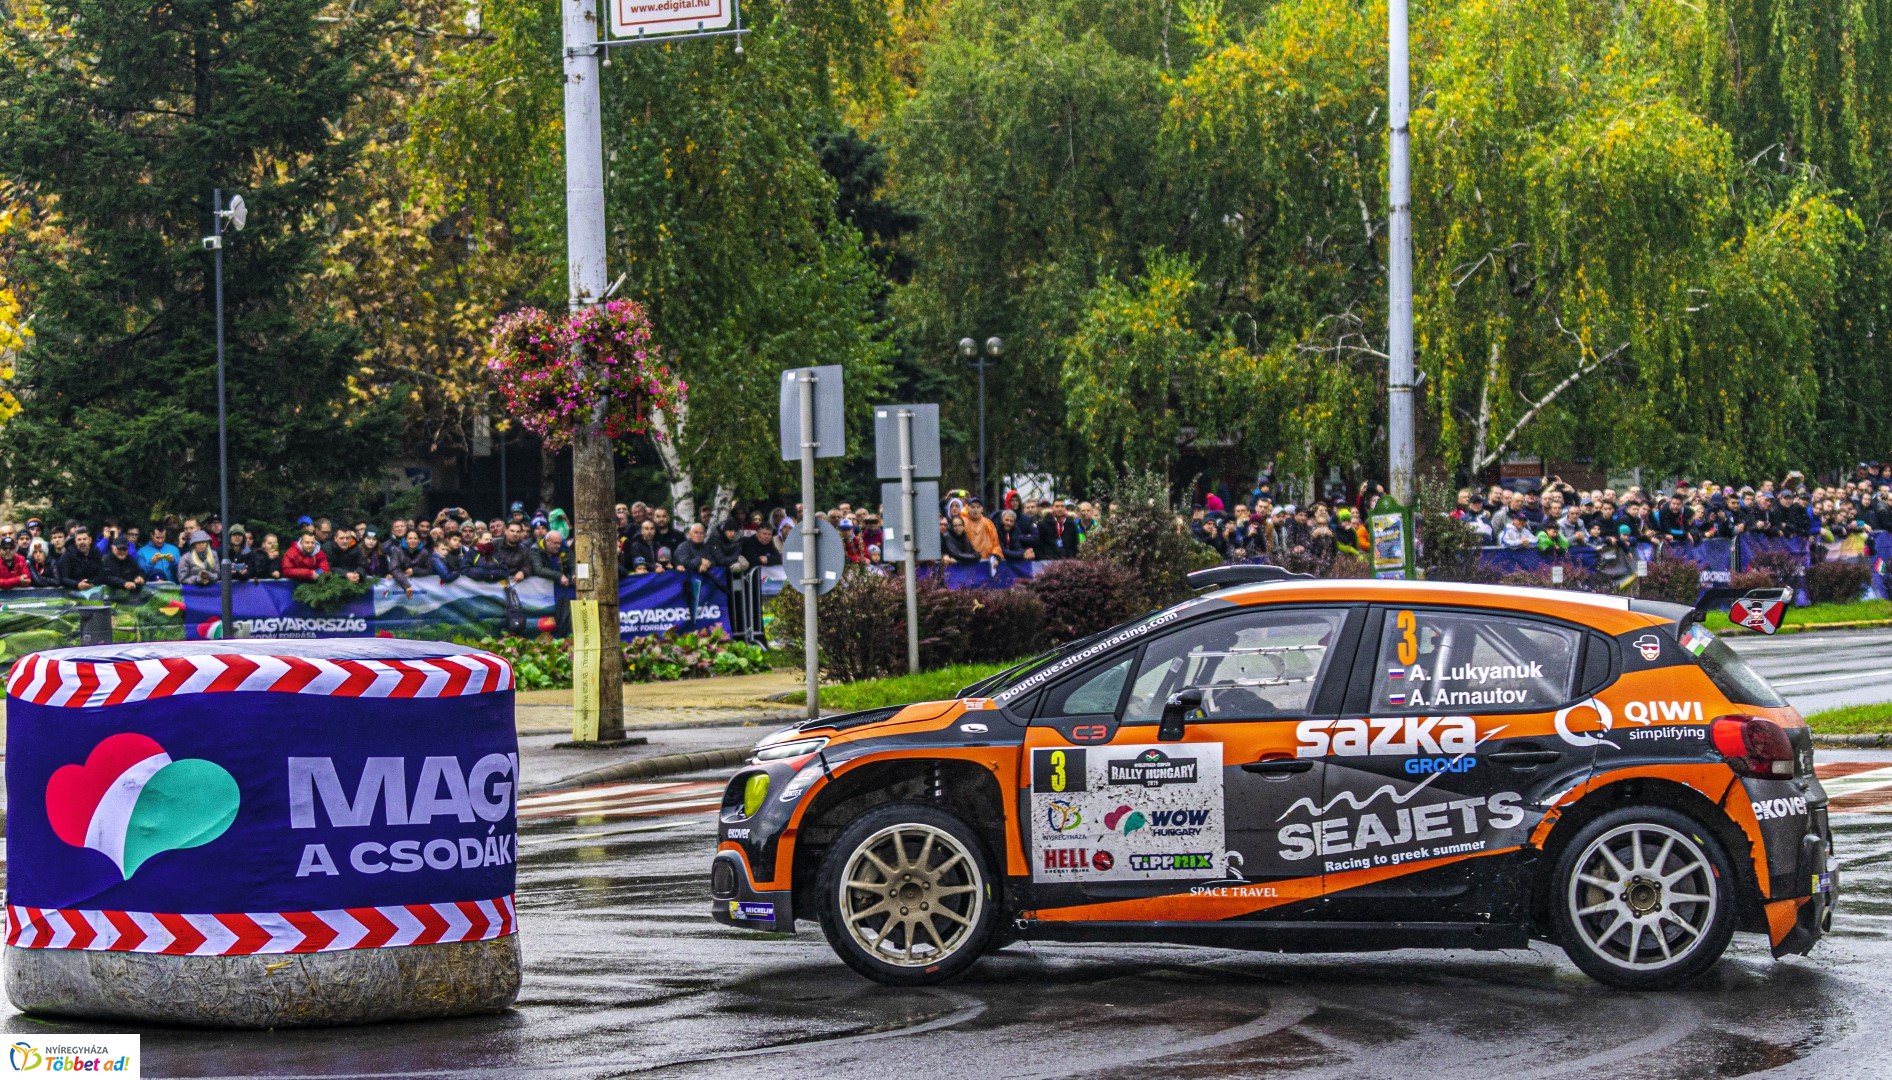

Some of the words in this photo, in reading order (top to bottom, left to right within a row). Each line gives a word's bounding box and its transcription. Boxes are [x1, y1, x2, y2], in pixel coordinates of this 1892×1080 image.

[630, 0, 711, 14] www.edigital.hu
[619, 602, 721, 624] AGYARORSZÁG
[1396, 610, 1417, 666] 3
[1001, 611, 1178, 700] boutique.citroenracing.com
[1409, 664, 1431, 681] A.
[1439, 661, 1543, 684] Lukyanuk
[1409, 688, 1430, 706] A.
[1435, 687, 1528, 705] Arnautov
[1624, 701, 1704, 726] QIWI
[1072, 724, 1107, 740] C3
[1629, 727, 1705, 741] simplifying
[1051, 750, 1067, 792] 3
[1111, 766, 1143, 780] RALLY
[1145, 764, 1195, 779] HUNGARY
[1405, 757, 1477, 774] GROUP
[288, 752, 517, 828] MAG
[1151, 809, 1209, 827] WOW
[1278, 791, 1524, 861] SEAJETS
[728, 828, 750, 839] ekover
[1153, 828, 1201, 837] HUNGARY
[295, 843, 340, 877] A
[350, 825, 512, 874] CSODÁK
[1044, 848, 1089, 869] HELL
[1325, 857, 1370, 872] Racing
[1374, 854, 1388, 865] to
[1391, 848, 1430, 865] greek
[1433, 841, 1486, 856] summer
[1190, 887, 1227, 898] SPACE
[1231, 887, 1278, 898] TRAVEL
